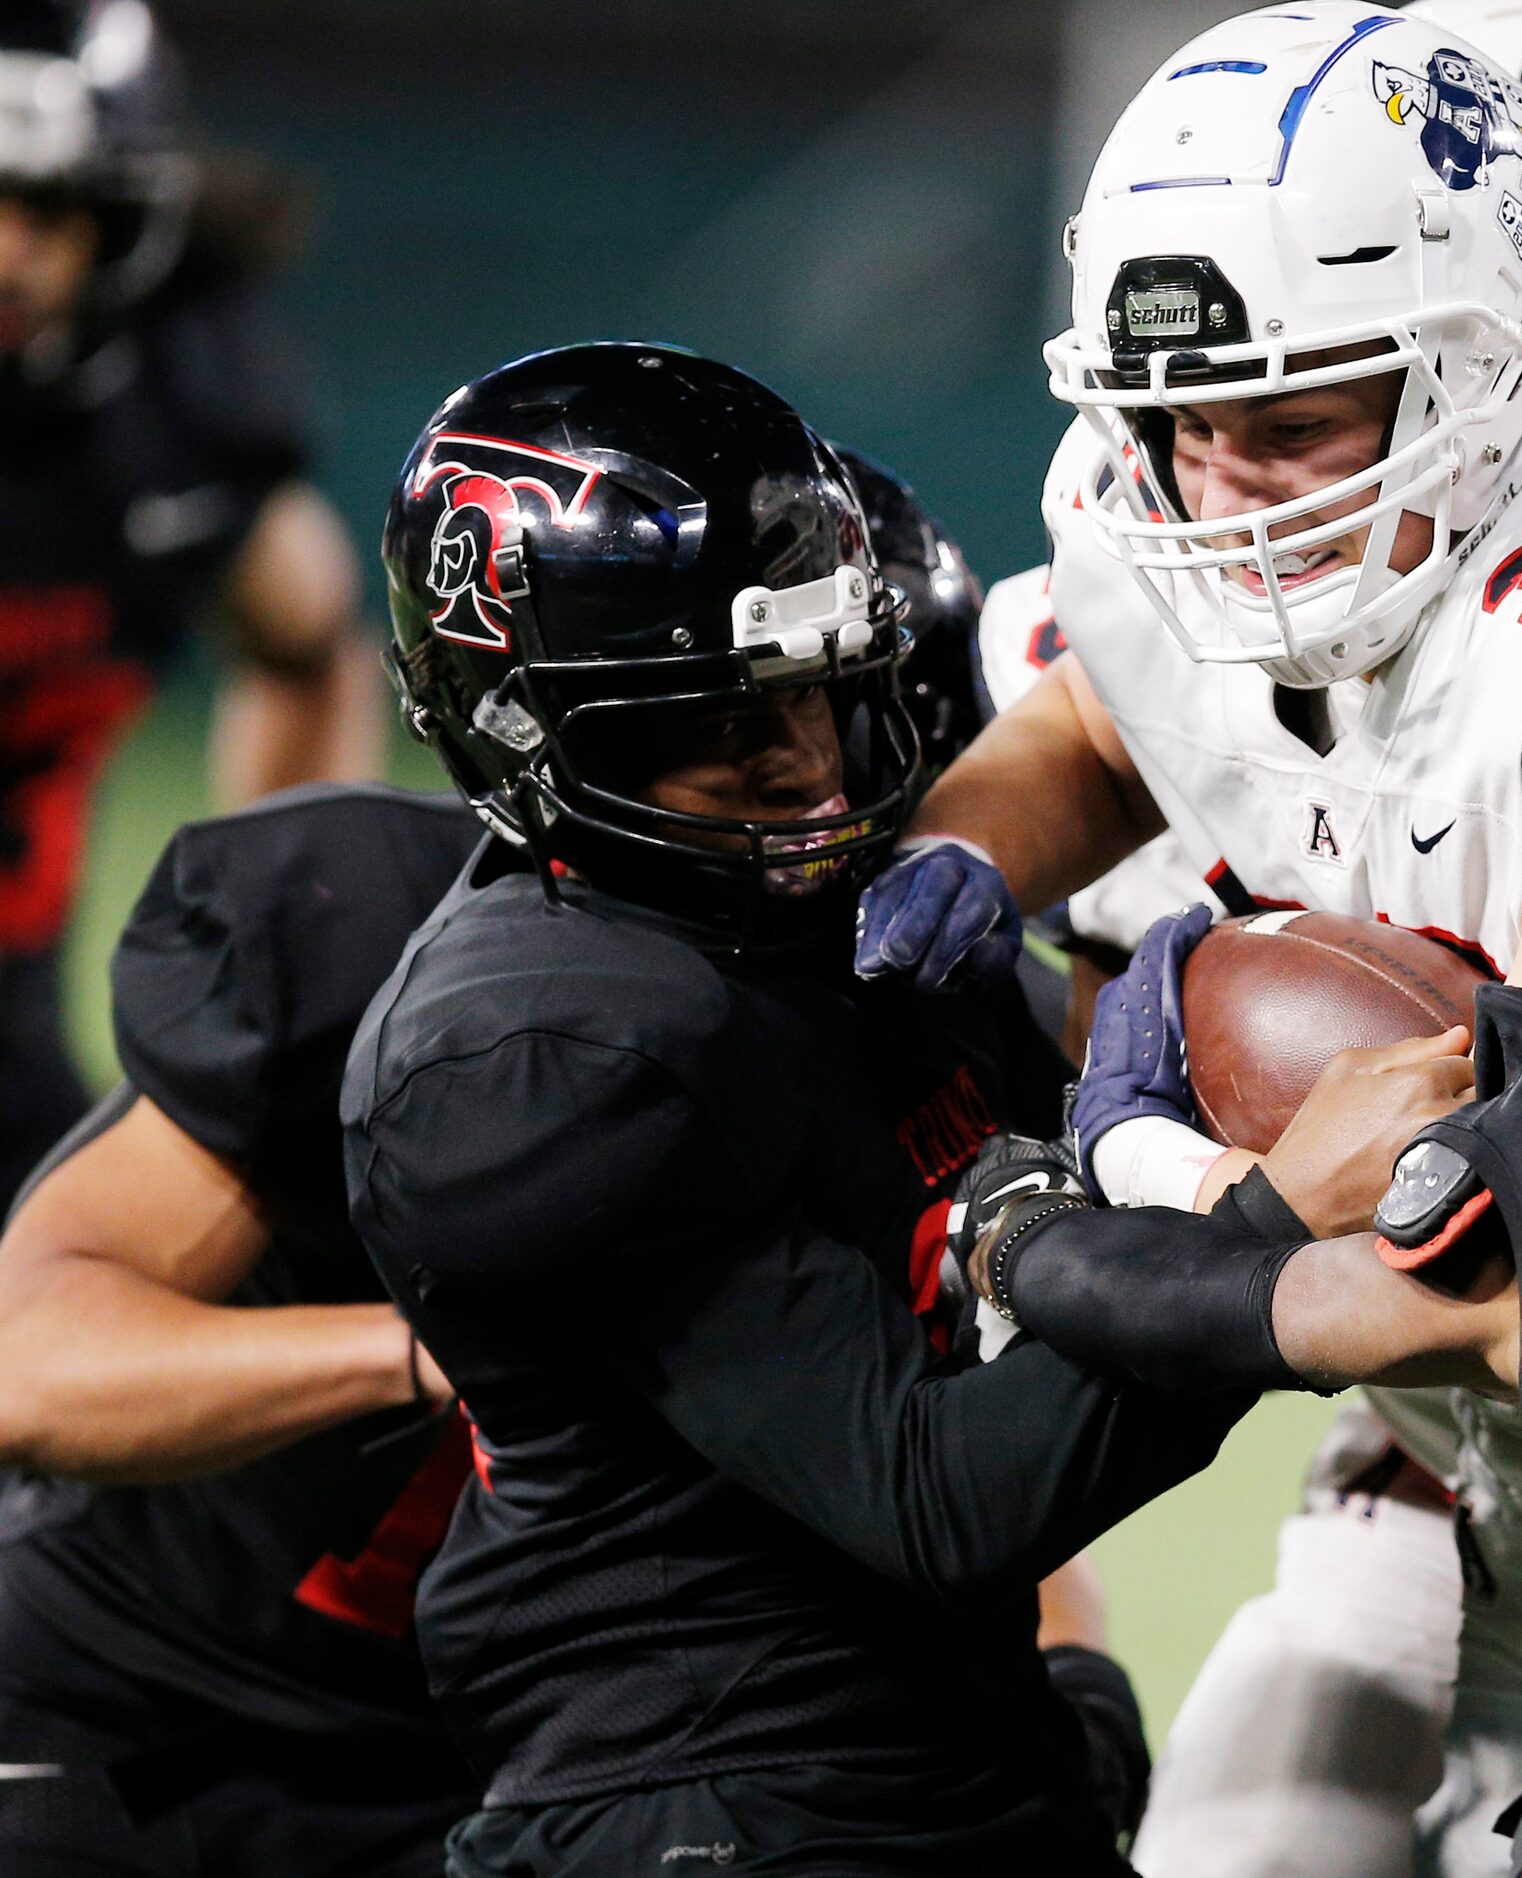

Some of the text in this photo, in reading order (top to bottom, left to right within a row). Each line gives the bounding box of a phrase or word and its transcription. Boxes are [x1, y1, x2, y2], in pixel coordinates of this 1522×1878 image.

[1438, 99, 1484, 145] A
[1130, 302, 1199, 325] schutt
[1306, 803, 1342, 862] A
